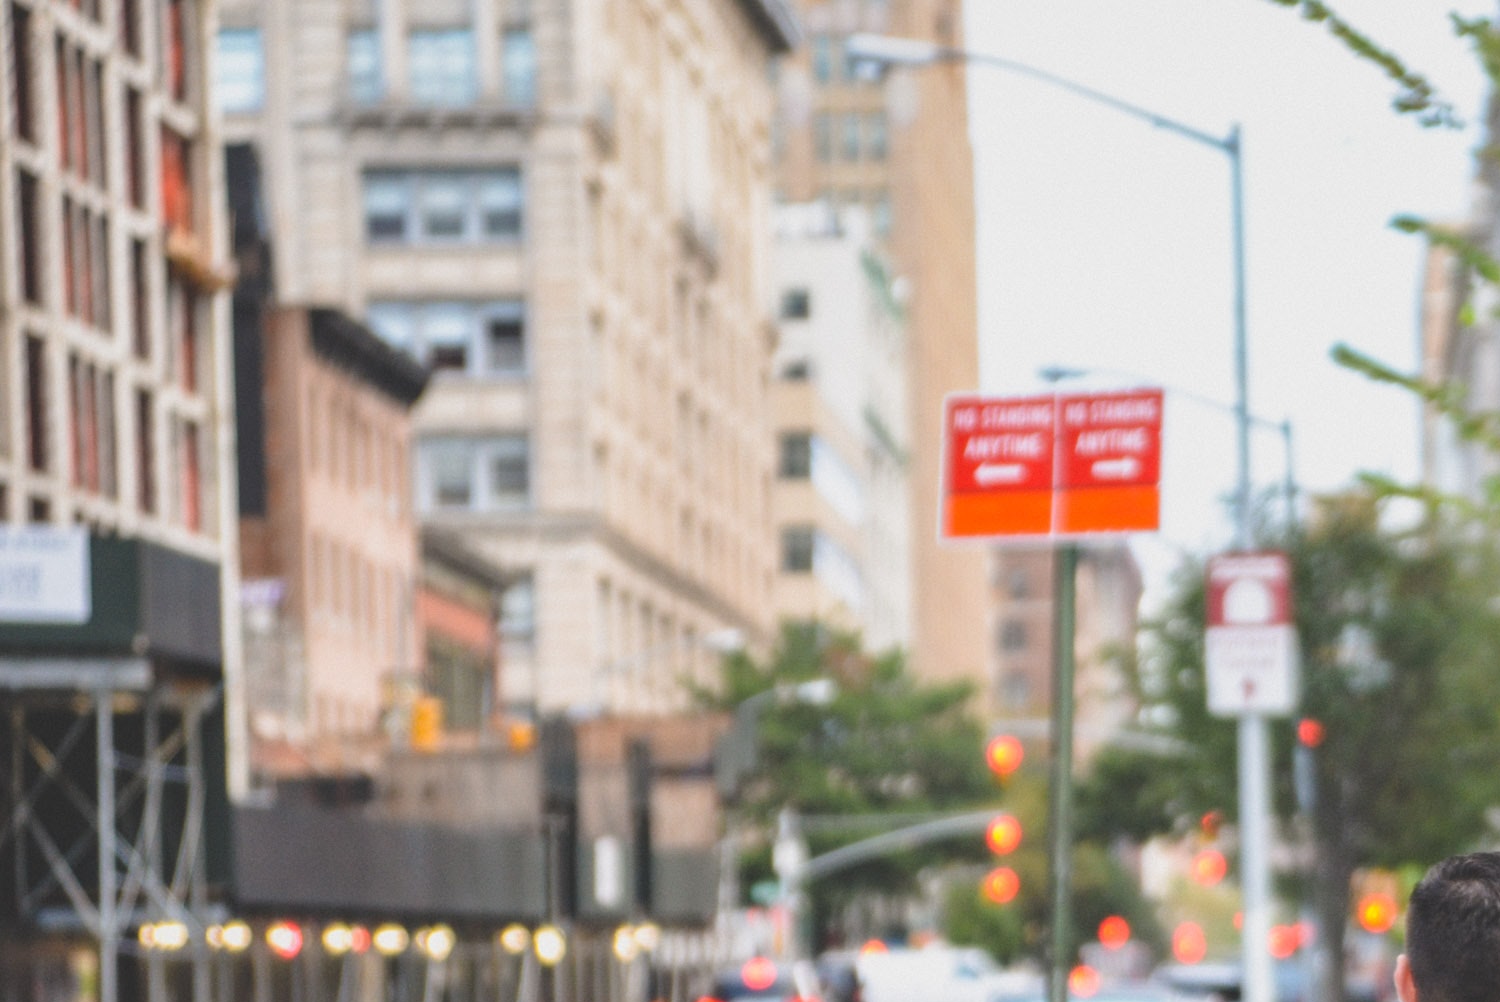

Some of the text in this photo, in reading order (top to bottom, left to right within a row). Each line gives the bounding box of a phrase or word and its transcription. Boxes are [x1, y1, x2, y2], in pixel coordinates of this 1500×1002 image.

[953, 403, 1051, 431] NO STANDING
[1065, 397, 1157, 425] NO STANDING
[963, 432, 1042, 458] ANYTIME
[1074, 426, 1148, 455] ANYTIME
